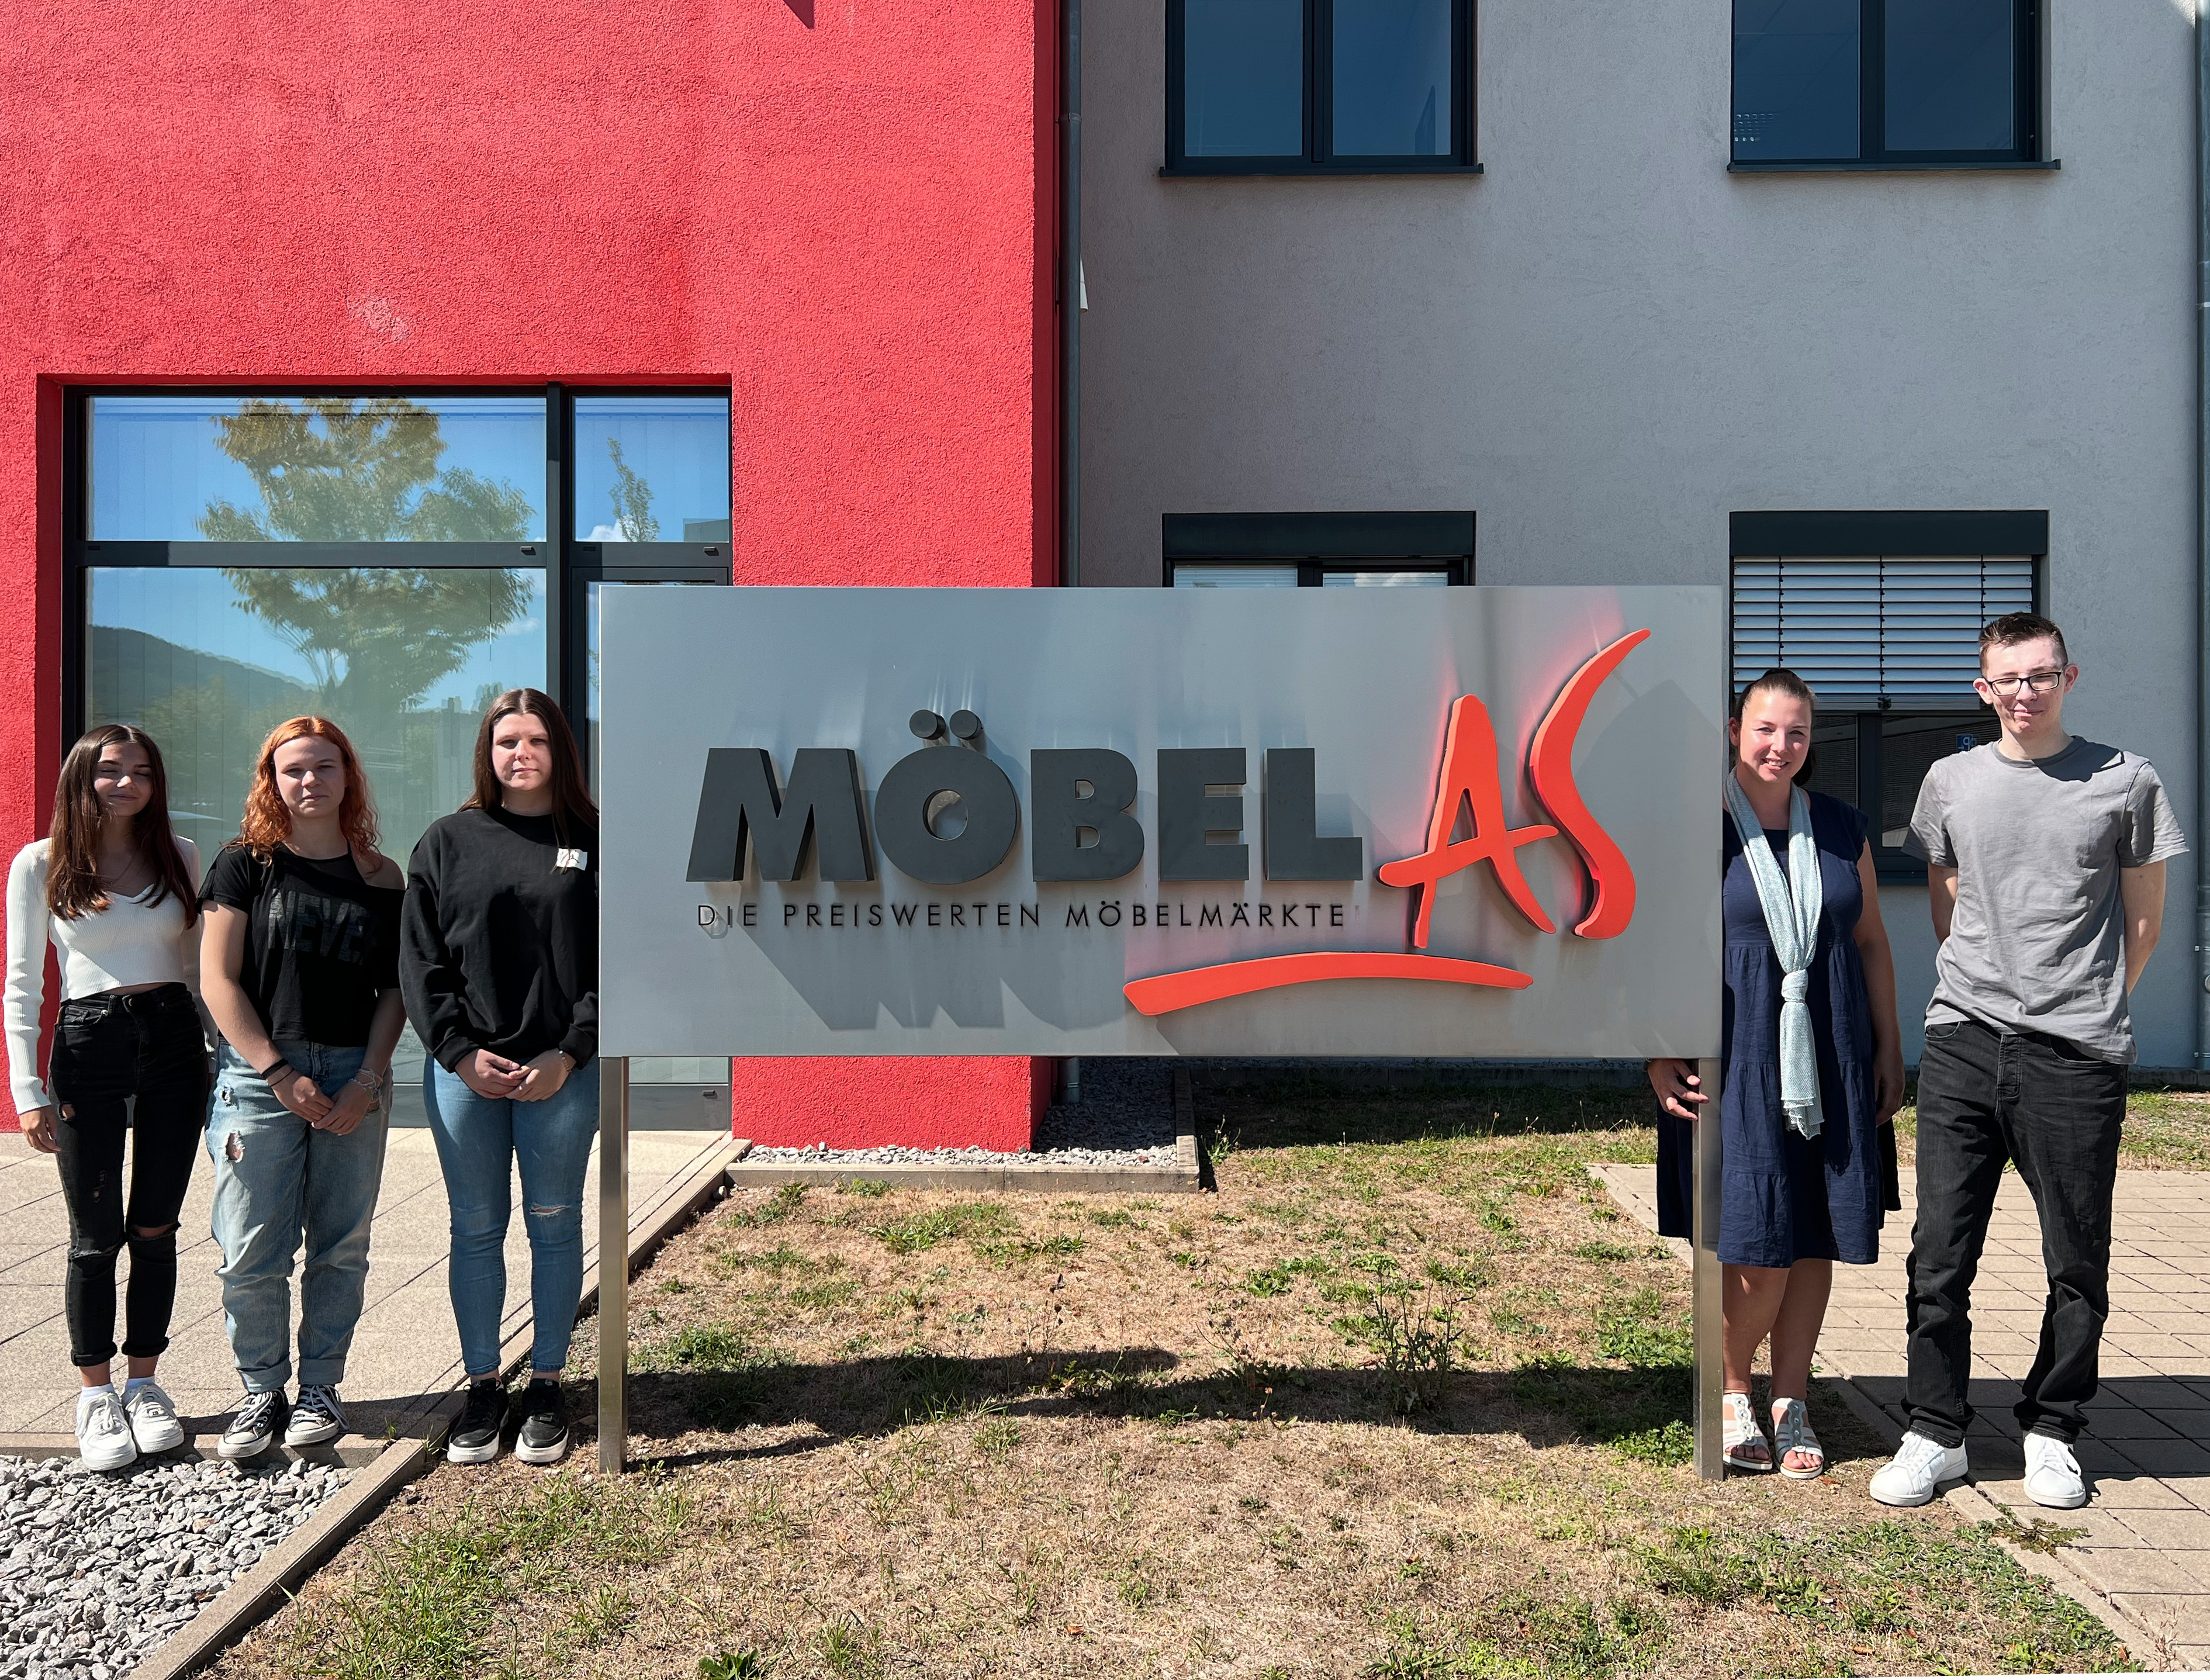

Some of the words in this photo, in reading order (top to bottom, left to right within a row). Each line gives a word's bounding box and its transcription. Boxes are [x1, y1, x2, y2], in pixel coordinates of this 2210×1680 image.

[686, 709, 1363, 885] MÖBEL
[1378, 628, 1651, 949] AS
[268, 887, 377, 965] NEVE
[697, 904, 758, 927] DIE
[783, 904, 1040, 927] PREISWERTEN
[1065, 900, 1344, 927] MÖBELMÄRKTE
